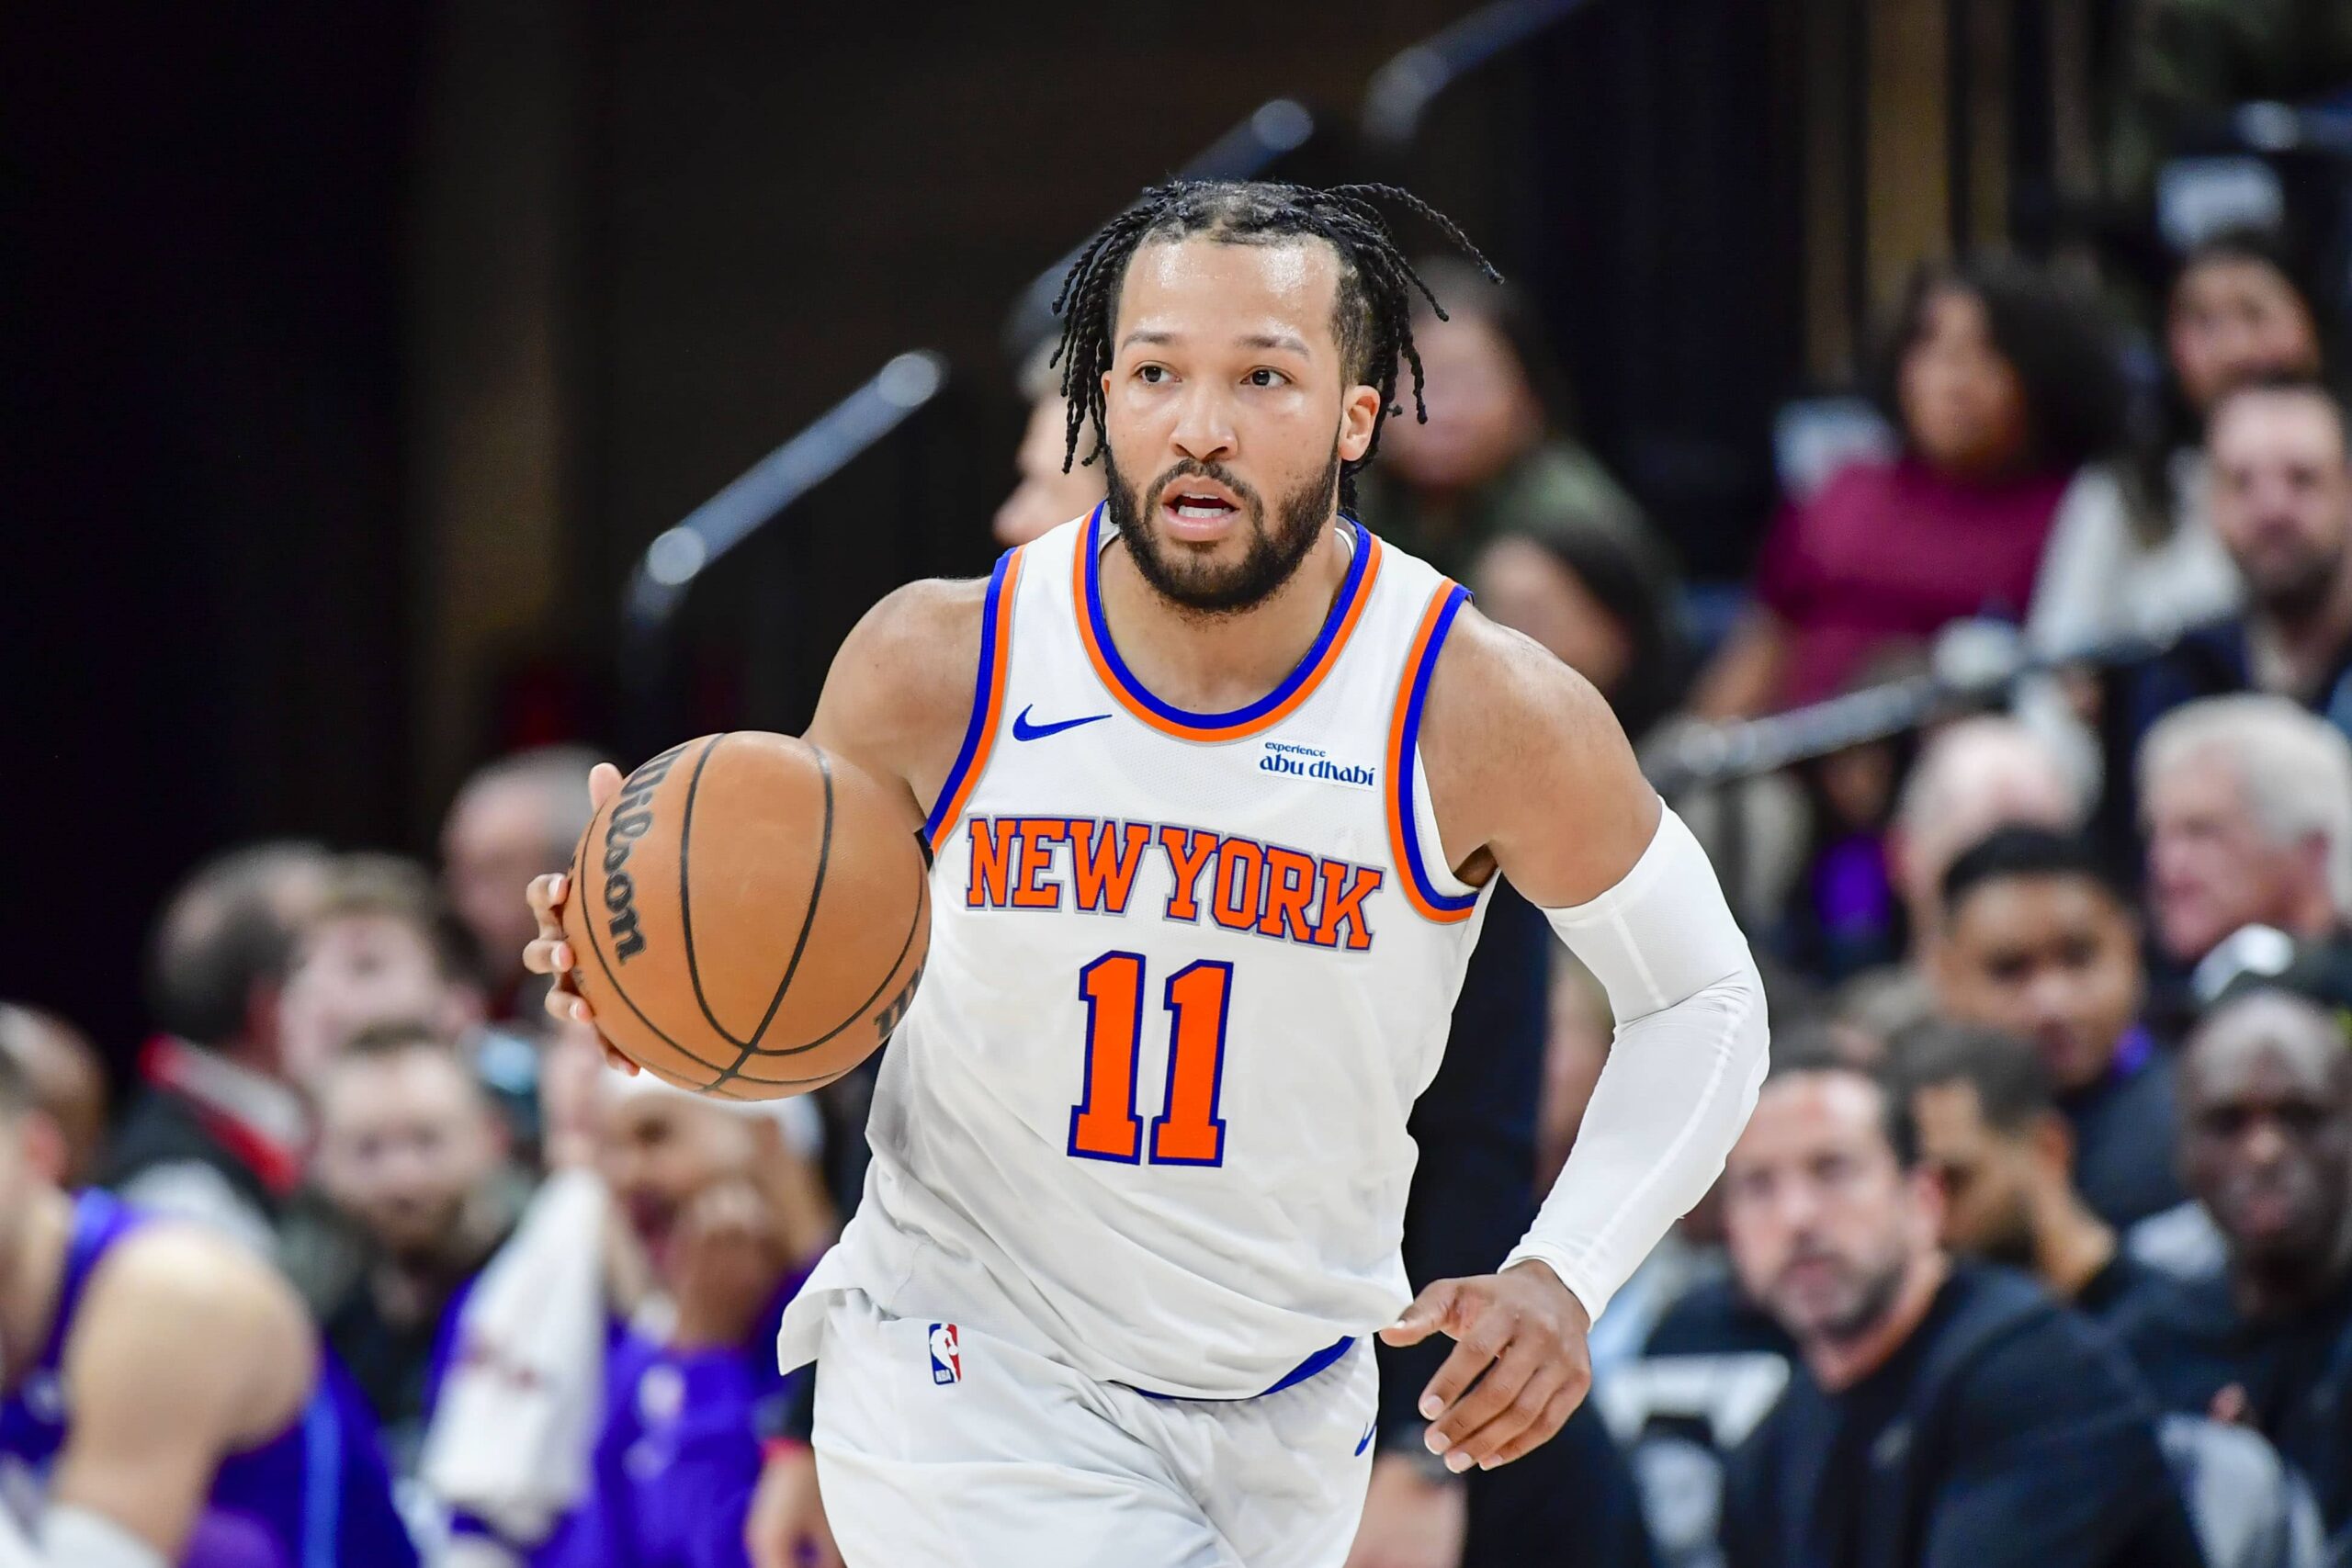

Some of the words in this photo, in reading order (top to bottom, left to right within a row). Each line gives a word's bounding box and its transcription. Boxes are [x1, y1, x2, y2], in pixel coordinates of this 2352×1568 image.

[1264, 741, 1327, 758] experience
[1260, 753, 1305, 776] abu
[966, 814, 1154, 914] NEW
[1158, 823, 1386, 953] YORK
[1067, 950, 1234, 1167] 11
[934, 1369, 953, 1382] NBA
